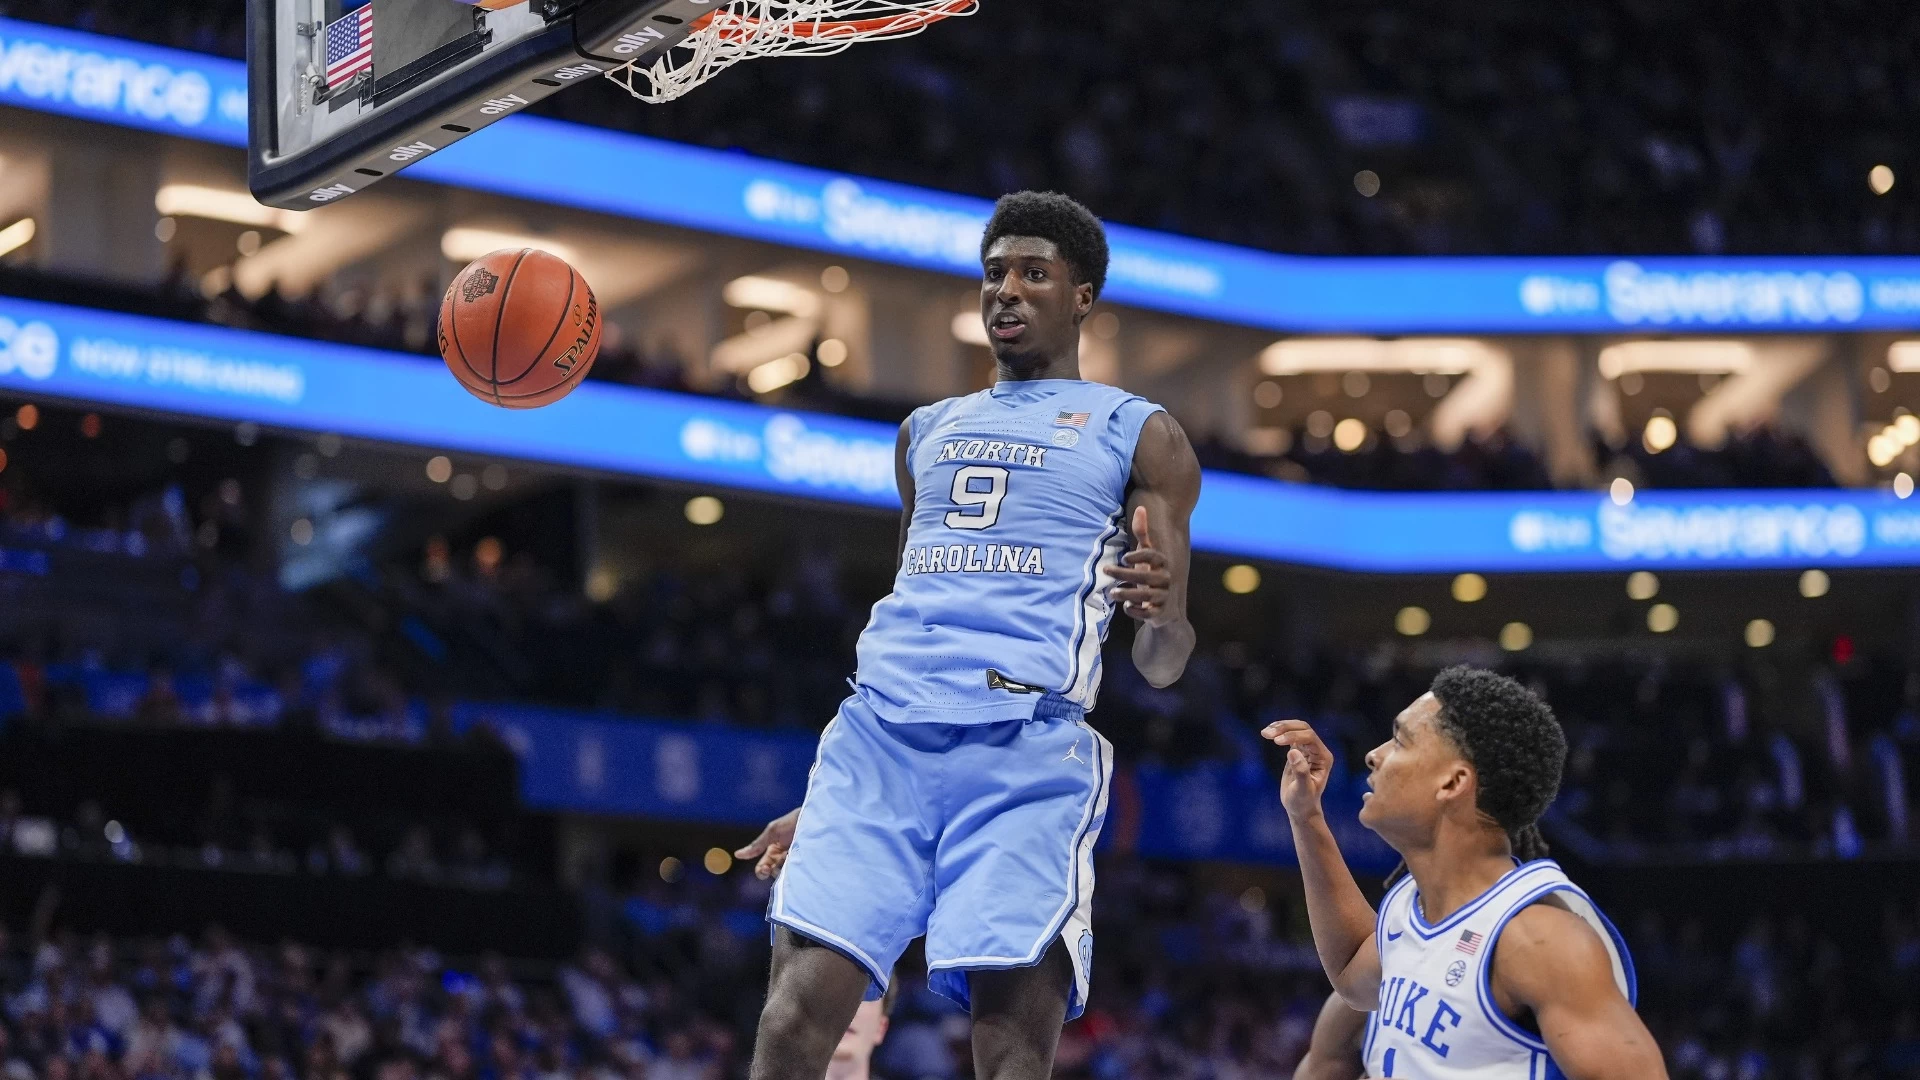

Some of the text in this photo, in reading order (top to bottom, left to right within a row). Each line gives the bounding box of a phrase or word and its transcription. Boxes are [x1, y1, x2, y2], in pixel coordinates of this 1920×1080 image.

[612, 26, 665, 54] ally
[554, 63, 604, 80] ally
[480, 93, 529, 115] ally
[389, 141, 437, 161] ally
[309, 183, 356, 201] ally
[935, 439, 1048, 467] NORTH
[943, 465, 1010, 531] 9
[906, 544, 1044, 575] CAROLINA
[1379, 976, 1462, 1058] UKE
